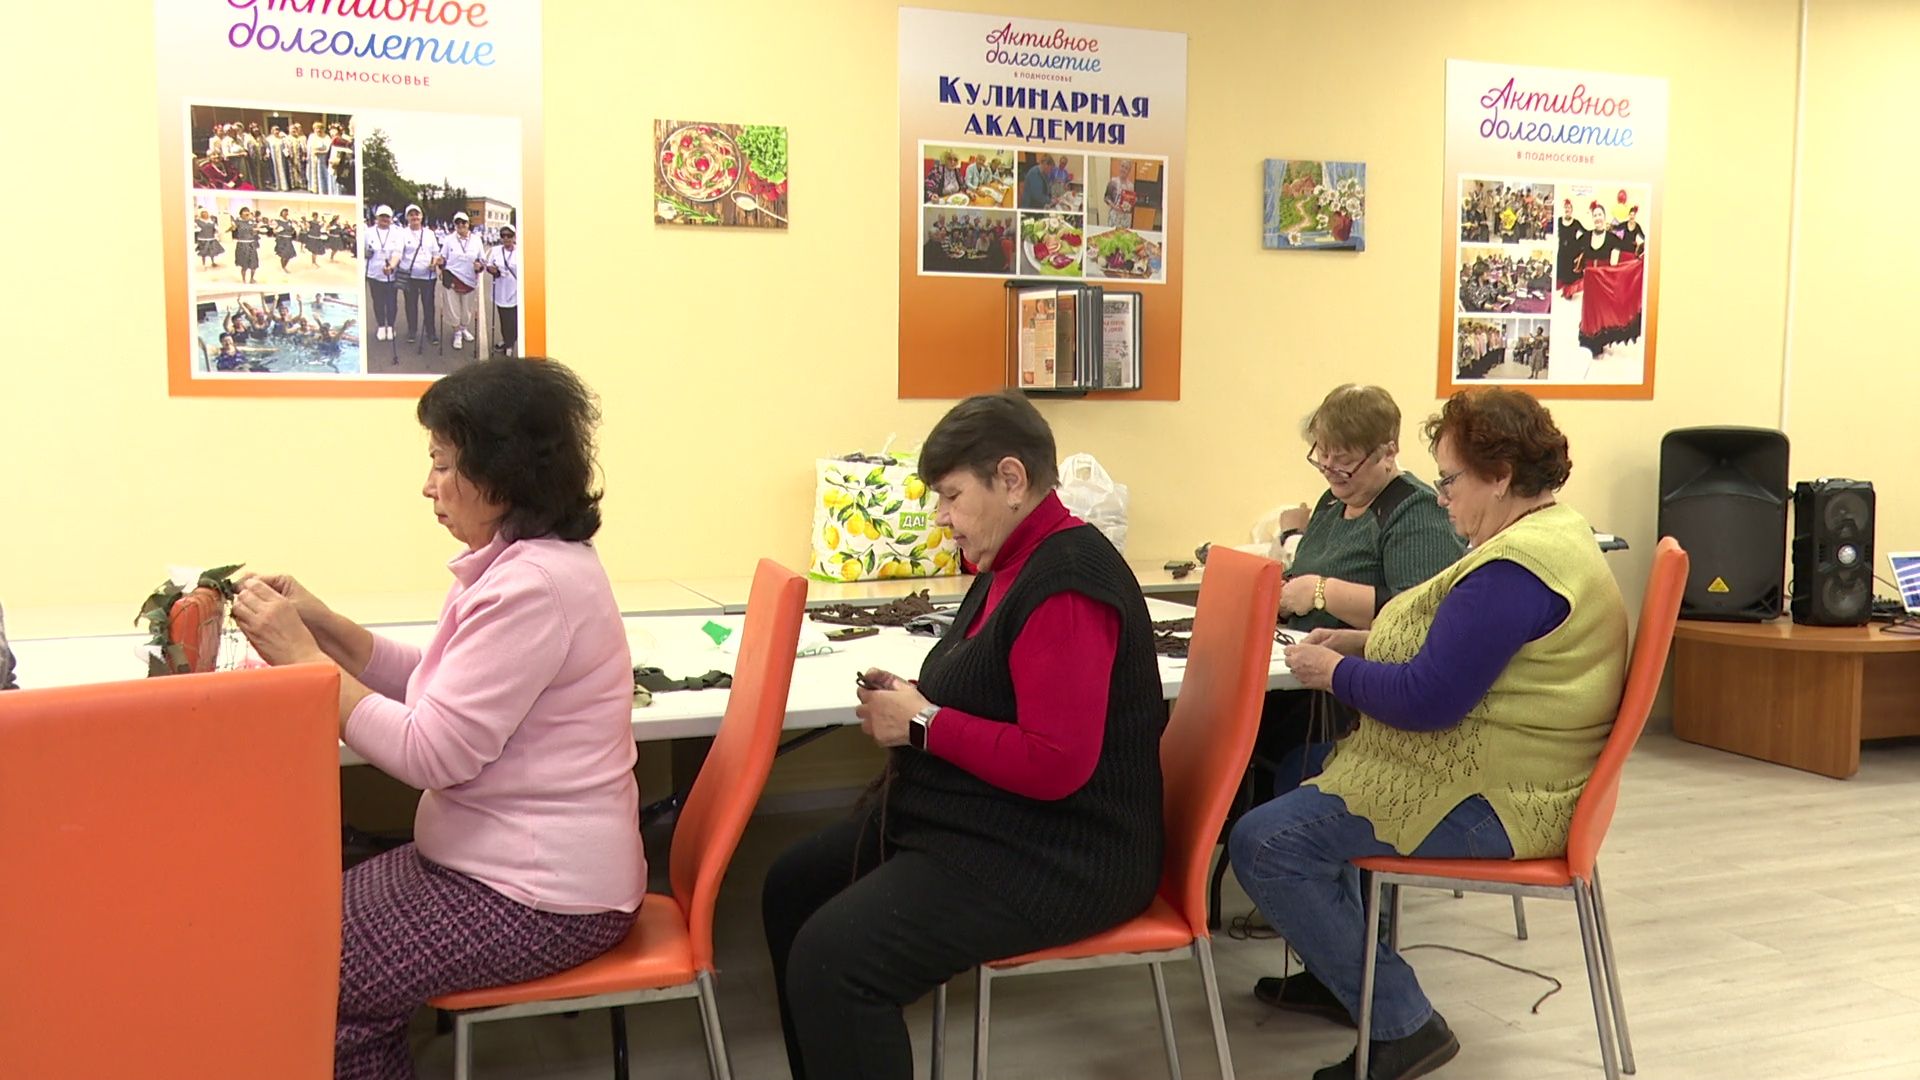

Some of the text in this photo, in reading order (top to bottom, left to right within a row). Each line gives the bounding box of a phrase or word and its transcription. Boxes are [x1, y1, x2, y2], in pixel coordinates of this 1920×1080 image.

[227, 0, 488, 28] тиное
[228, 5, 496, 67] долголетие
[986, 22, 1099, 53] Активное
[986, 42, 1101, 73] долголетие
[296, 67, 430, 87] В ПОДМОСКОВЬЕ
[939, 76, 1150, 118] КУЛИНАРНАЯ
[1480, 77, 1631, 118] Активное
[964, 113, 1126, 146] АКАДЕМИЯ
[1480, 106, 1633, 147] долголетие
[1517, 151, 1595, 165] В ПОДМОСКОВЬЕ
[902, 515, 924, 528] ДА!
